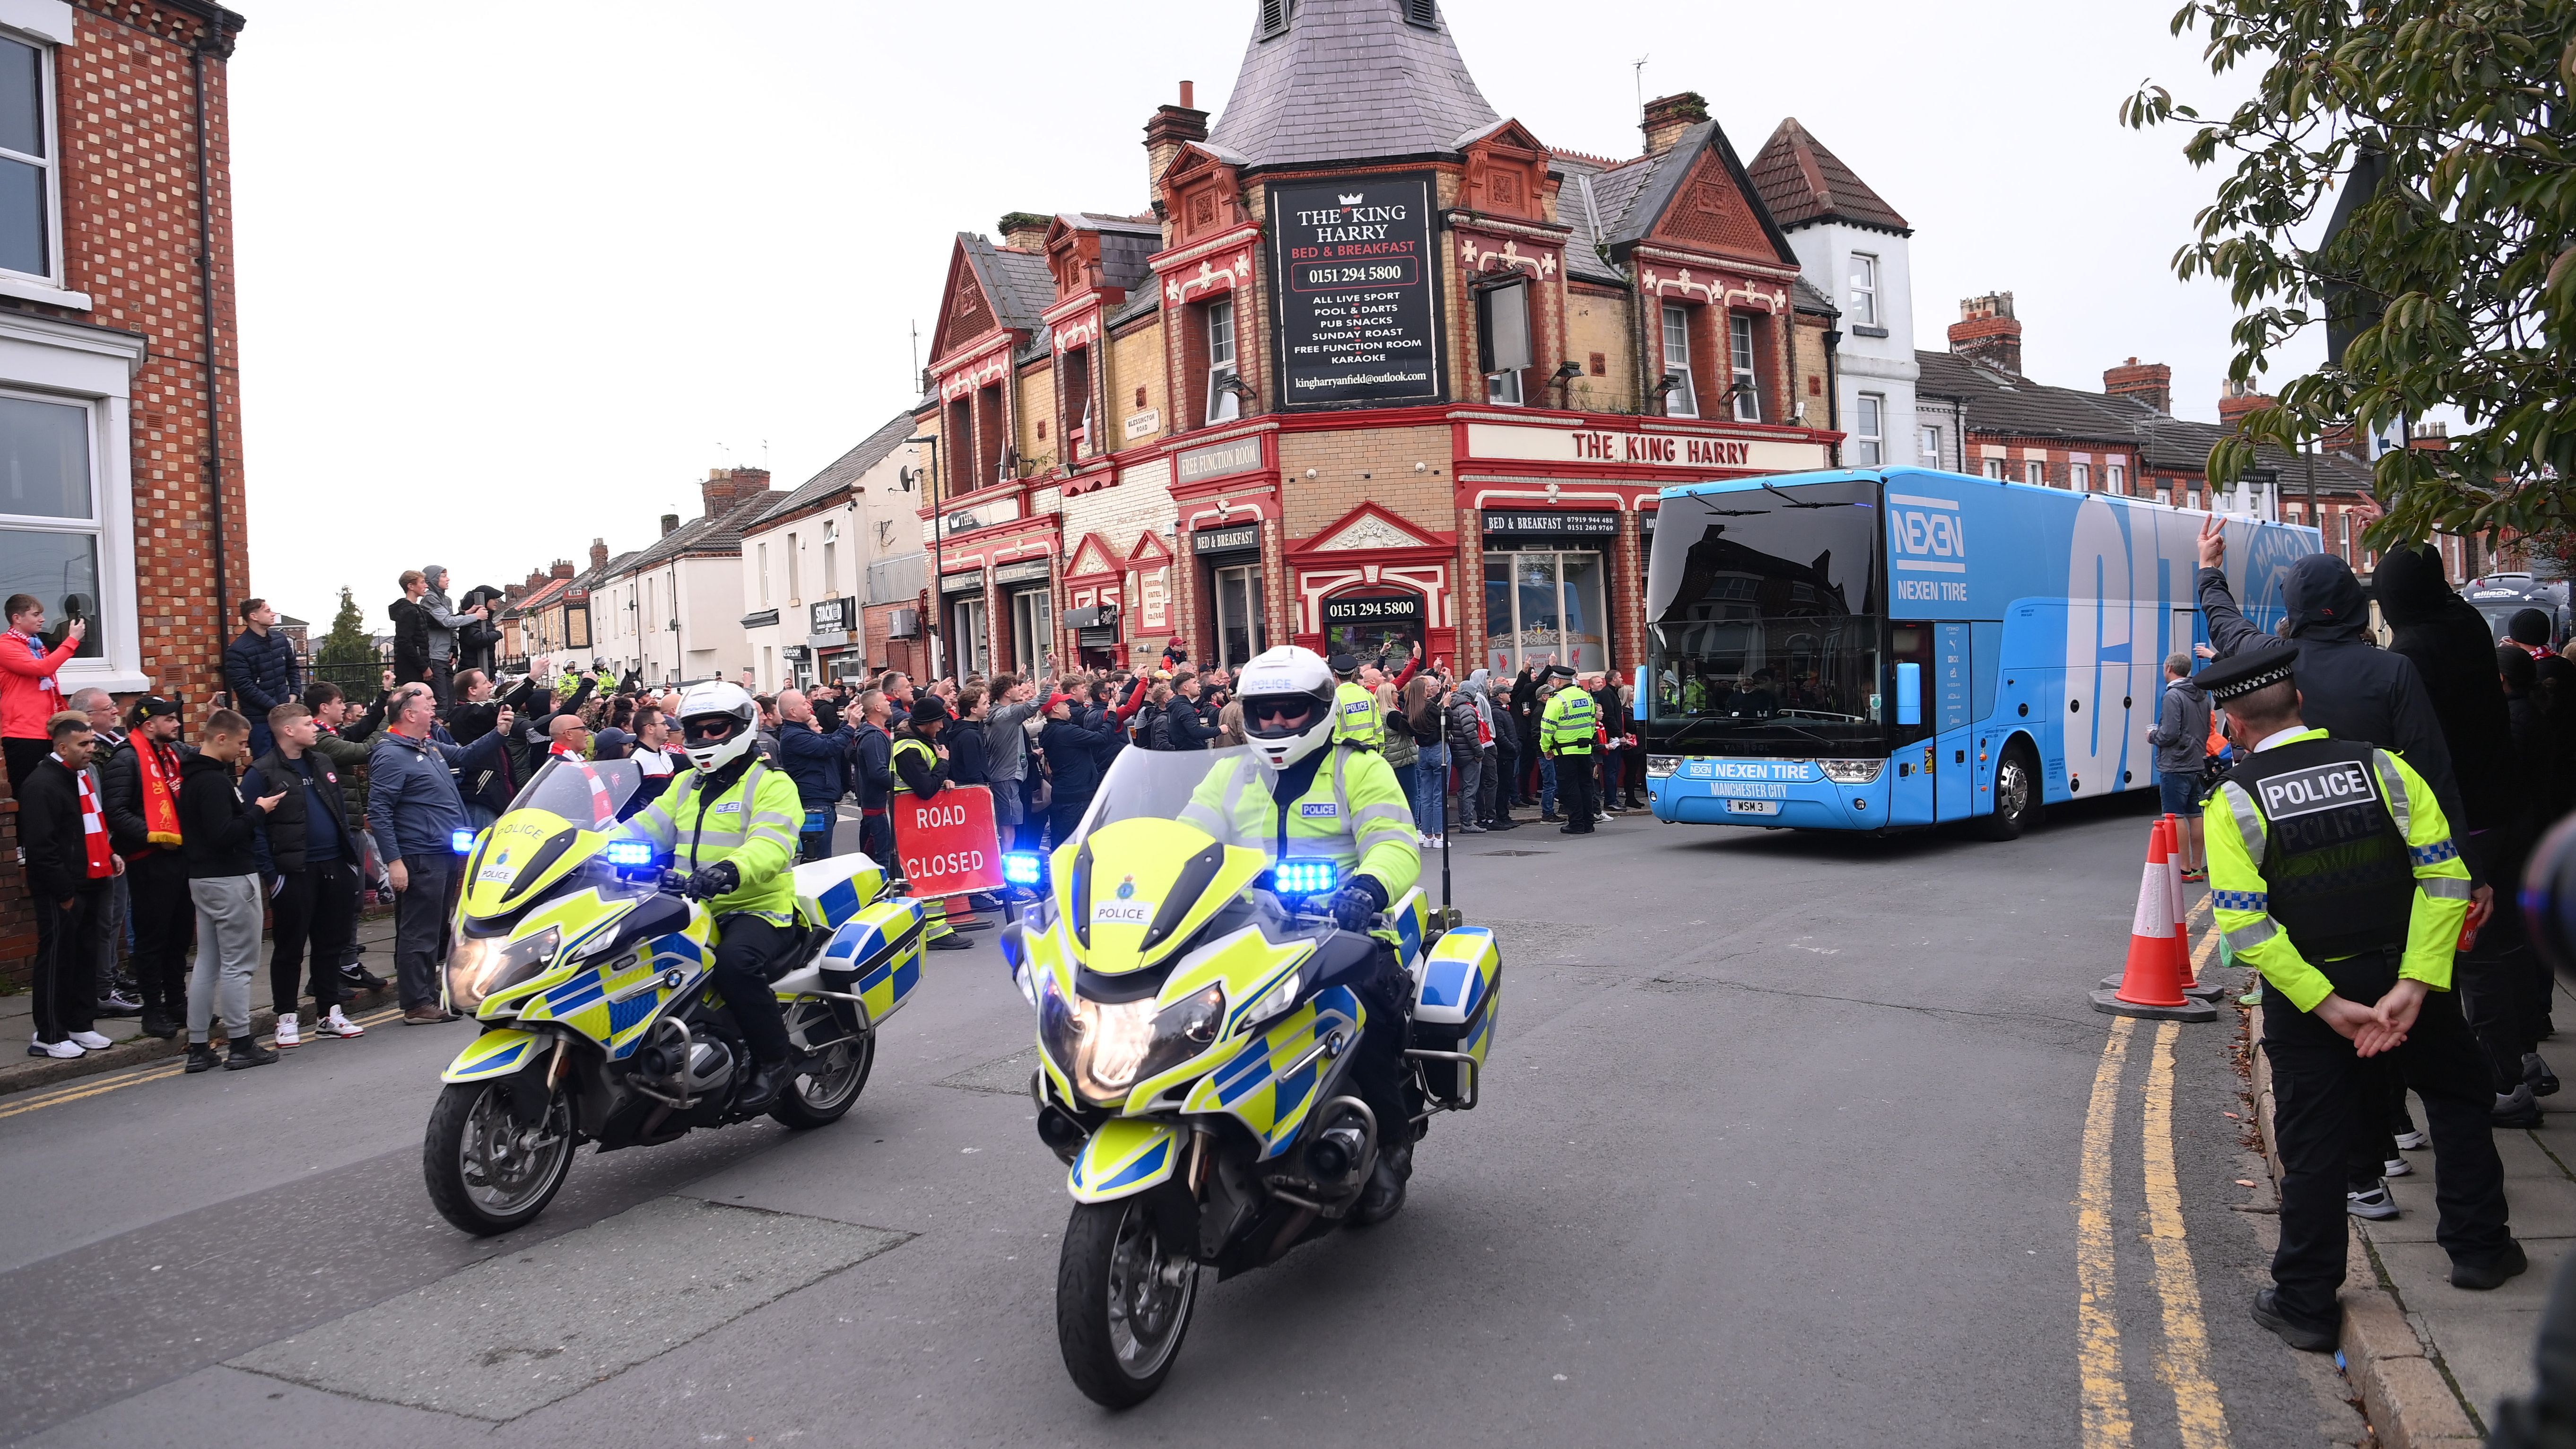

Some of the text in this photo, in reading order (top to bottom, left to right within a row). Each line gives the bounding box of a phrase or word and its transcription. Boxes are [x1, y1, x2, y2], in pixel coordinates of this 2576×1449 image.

[1297, 205, 1406, 226] THE KING
[1316, 224, 1388, 243] HARRY
[1292, 241, 1415, 259] BED & BREAKFAST
[1309, 266, 1401, 283] 0151 294 5800
[1313, 292, 1400, 304] ALL LIVE SPORT
[1314, 304, 1398, 316] POOL & DARTS
[1320, 316, 1393, 328] PUB SNACKS
[1312, 328, 1403, 340] SUNDAY ROAST
[1294, 339, 1422, 354] FREE FUNCTION ROOM
[1331, 354, 1386, 364] KARAOKE
[1295, 372, 1427, 390] kingharryanfield@outlook.com
[1128, 412, 1155, 428] BLESSINGTON
[1136, 424, 1148, 433] ROAD
[1573, 433, 1749, 464] THE KING HARRY
[1182, 445, 1256, 476] FREE FUNCTION ROOM
[959, 513, 973, 526] THE
[1488, 517, 1561, 529] BED & BREAKFAST
[1197, 531, 1253, 549] BED & BREAKFAST
[1897, 580, 1967, 601] NEXEN TIRE
[1330, 602, 1414, 617] 0151 294 5800
[1532, 660, 1545, 669] King
[1252, 679, 1292, 690] POLICE
[1346, 702, 1368, 713] POLICE
[1572, 699, 1589, 708] POLICE
[1715, 764, 1767, 778] NEXEN
[1771, 765, 1809, 779] TIRE
[1710, 783, 1786, 798] MANCHESTER CITY
[2266, 770, 2367, 809] POLICE
[717, 803, 740, 812] POLICE
[1304, 805, 1335, 814] POLICE
[1738, 802, 1756, 811] WSM
[1758, 803, 1763, 811] 3
[916, 805, 966, 829] ROAD
[496, 824, 544, 839] POLICE
[2279, 803, 2382, 851] POLICE
[907, 850, 983, 879] CLOSED
[481, 871, 511, 880] POLICE
[1098, 908, 1144, 919] POLICE
